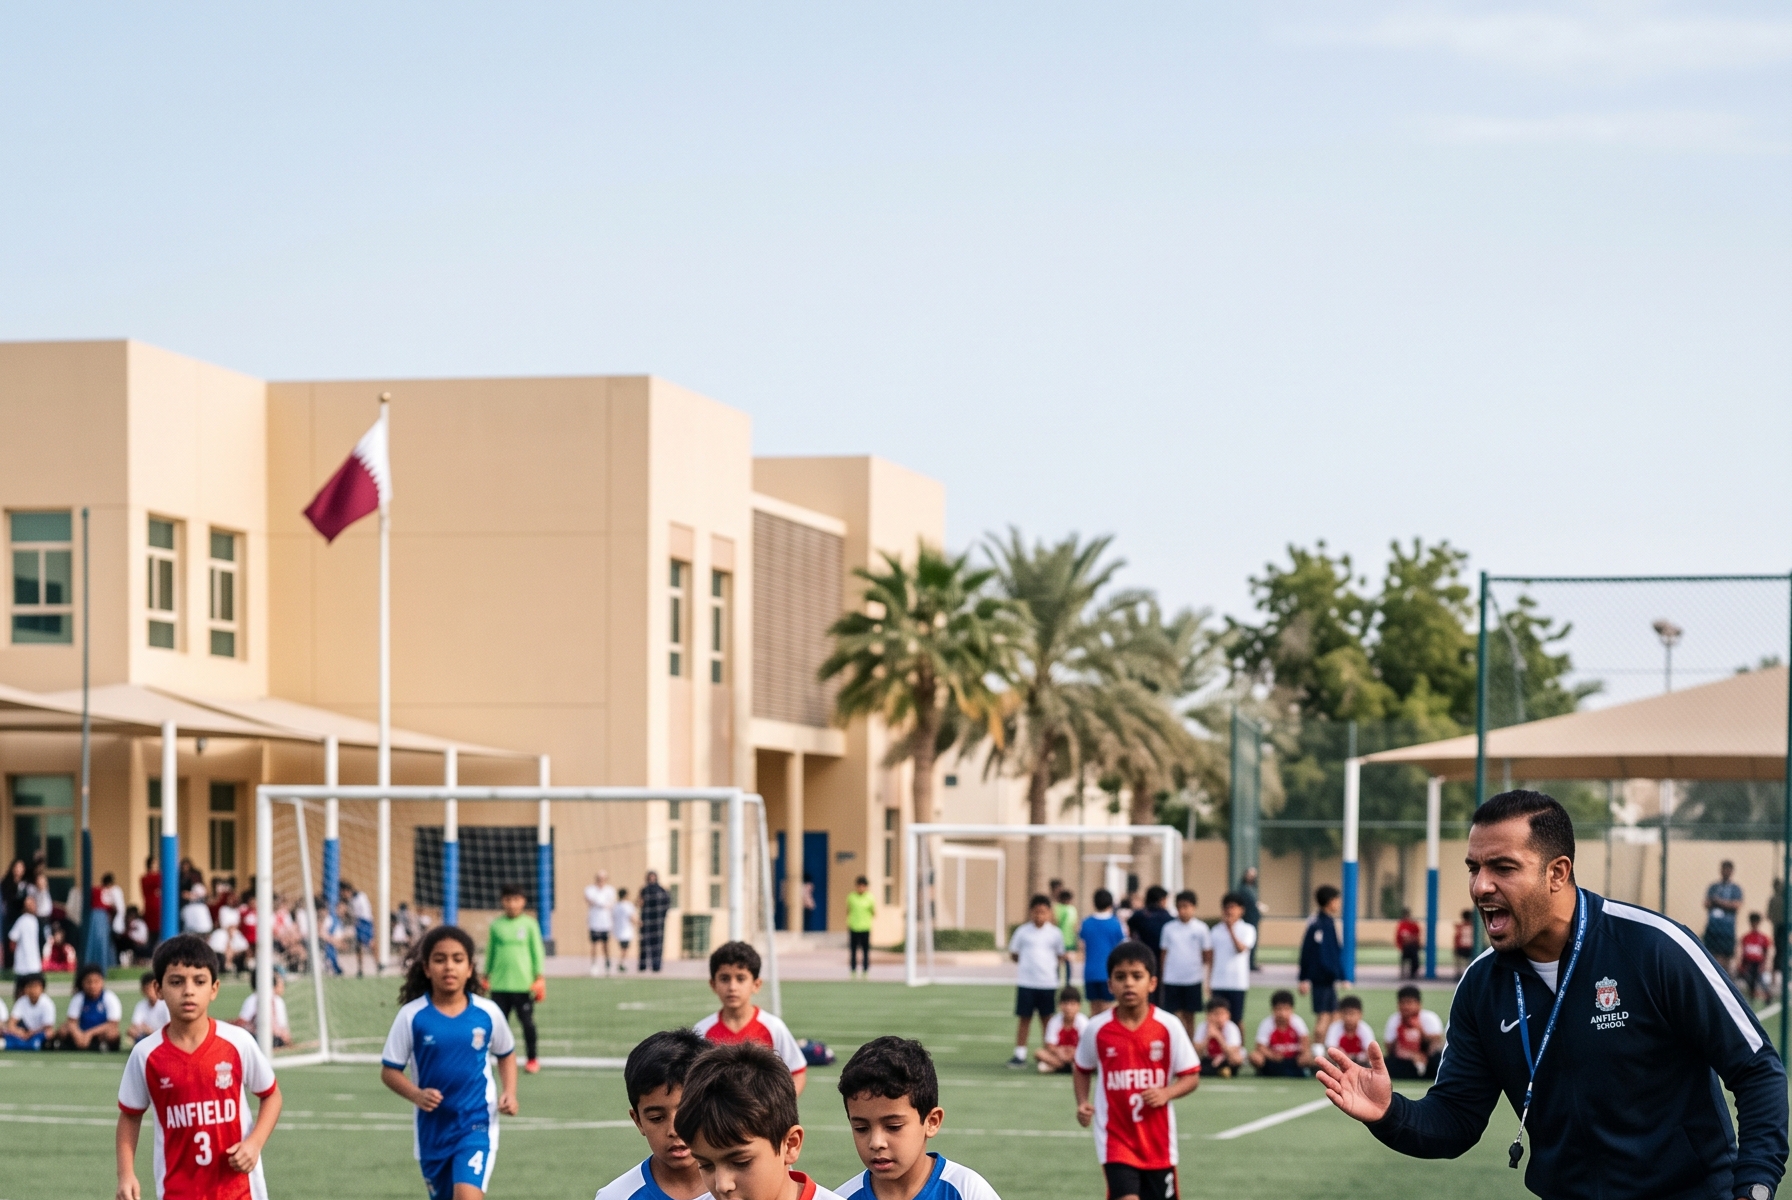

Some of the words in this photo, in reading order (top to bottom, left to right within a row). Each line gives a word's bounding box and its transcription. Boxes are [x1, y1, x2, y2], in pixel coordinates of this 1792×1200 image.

[1590, 1011, 1629, 1024] ANFIELD
[1596, 1020, 1625, 1030] SCHOOL
[1106, 1068, 1166, 1091] ANFIELD
[166, 1098, 236, 1129] ANFIELD
[1128, 1093, 1144, 1123] 2
[193, 1131, 213, 1166] 3
[467, 1150, 484, 1175] 4
